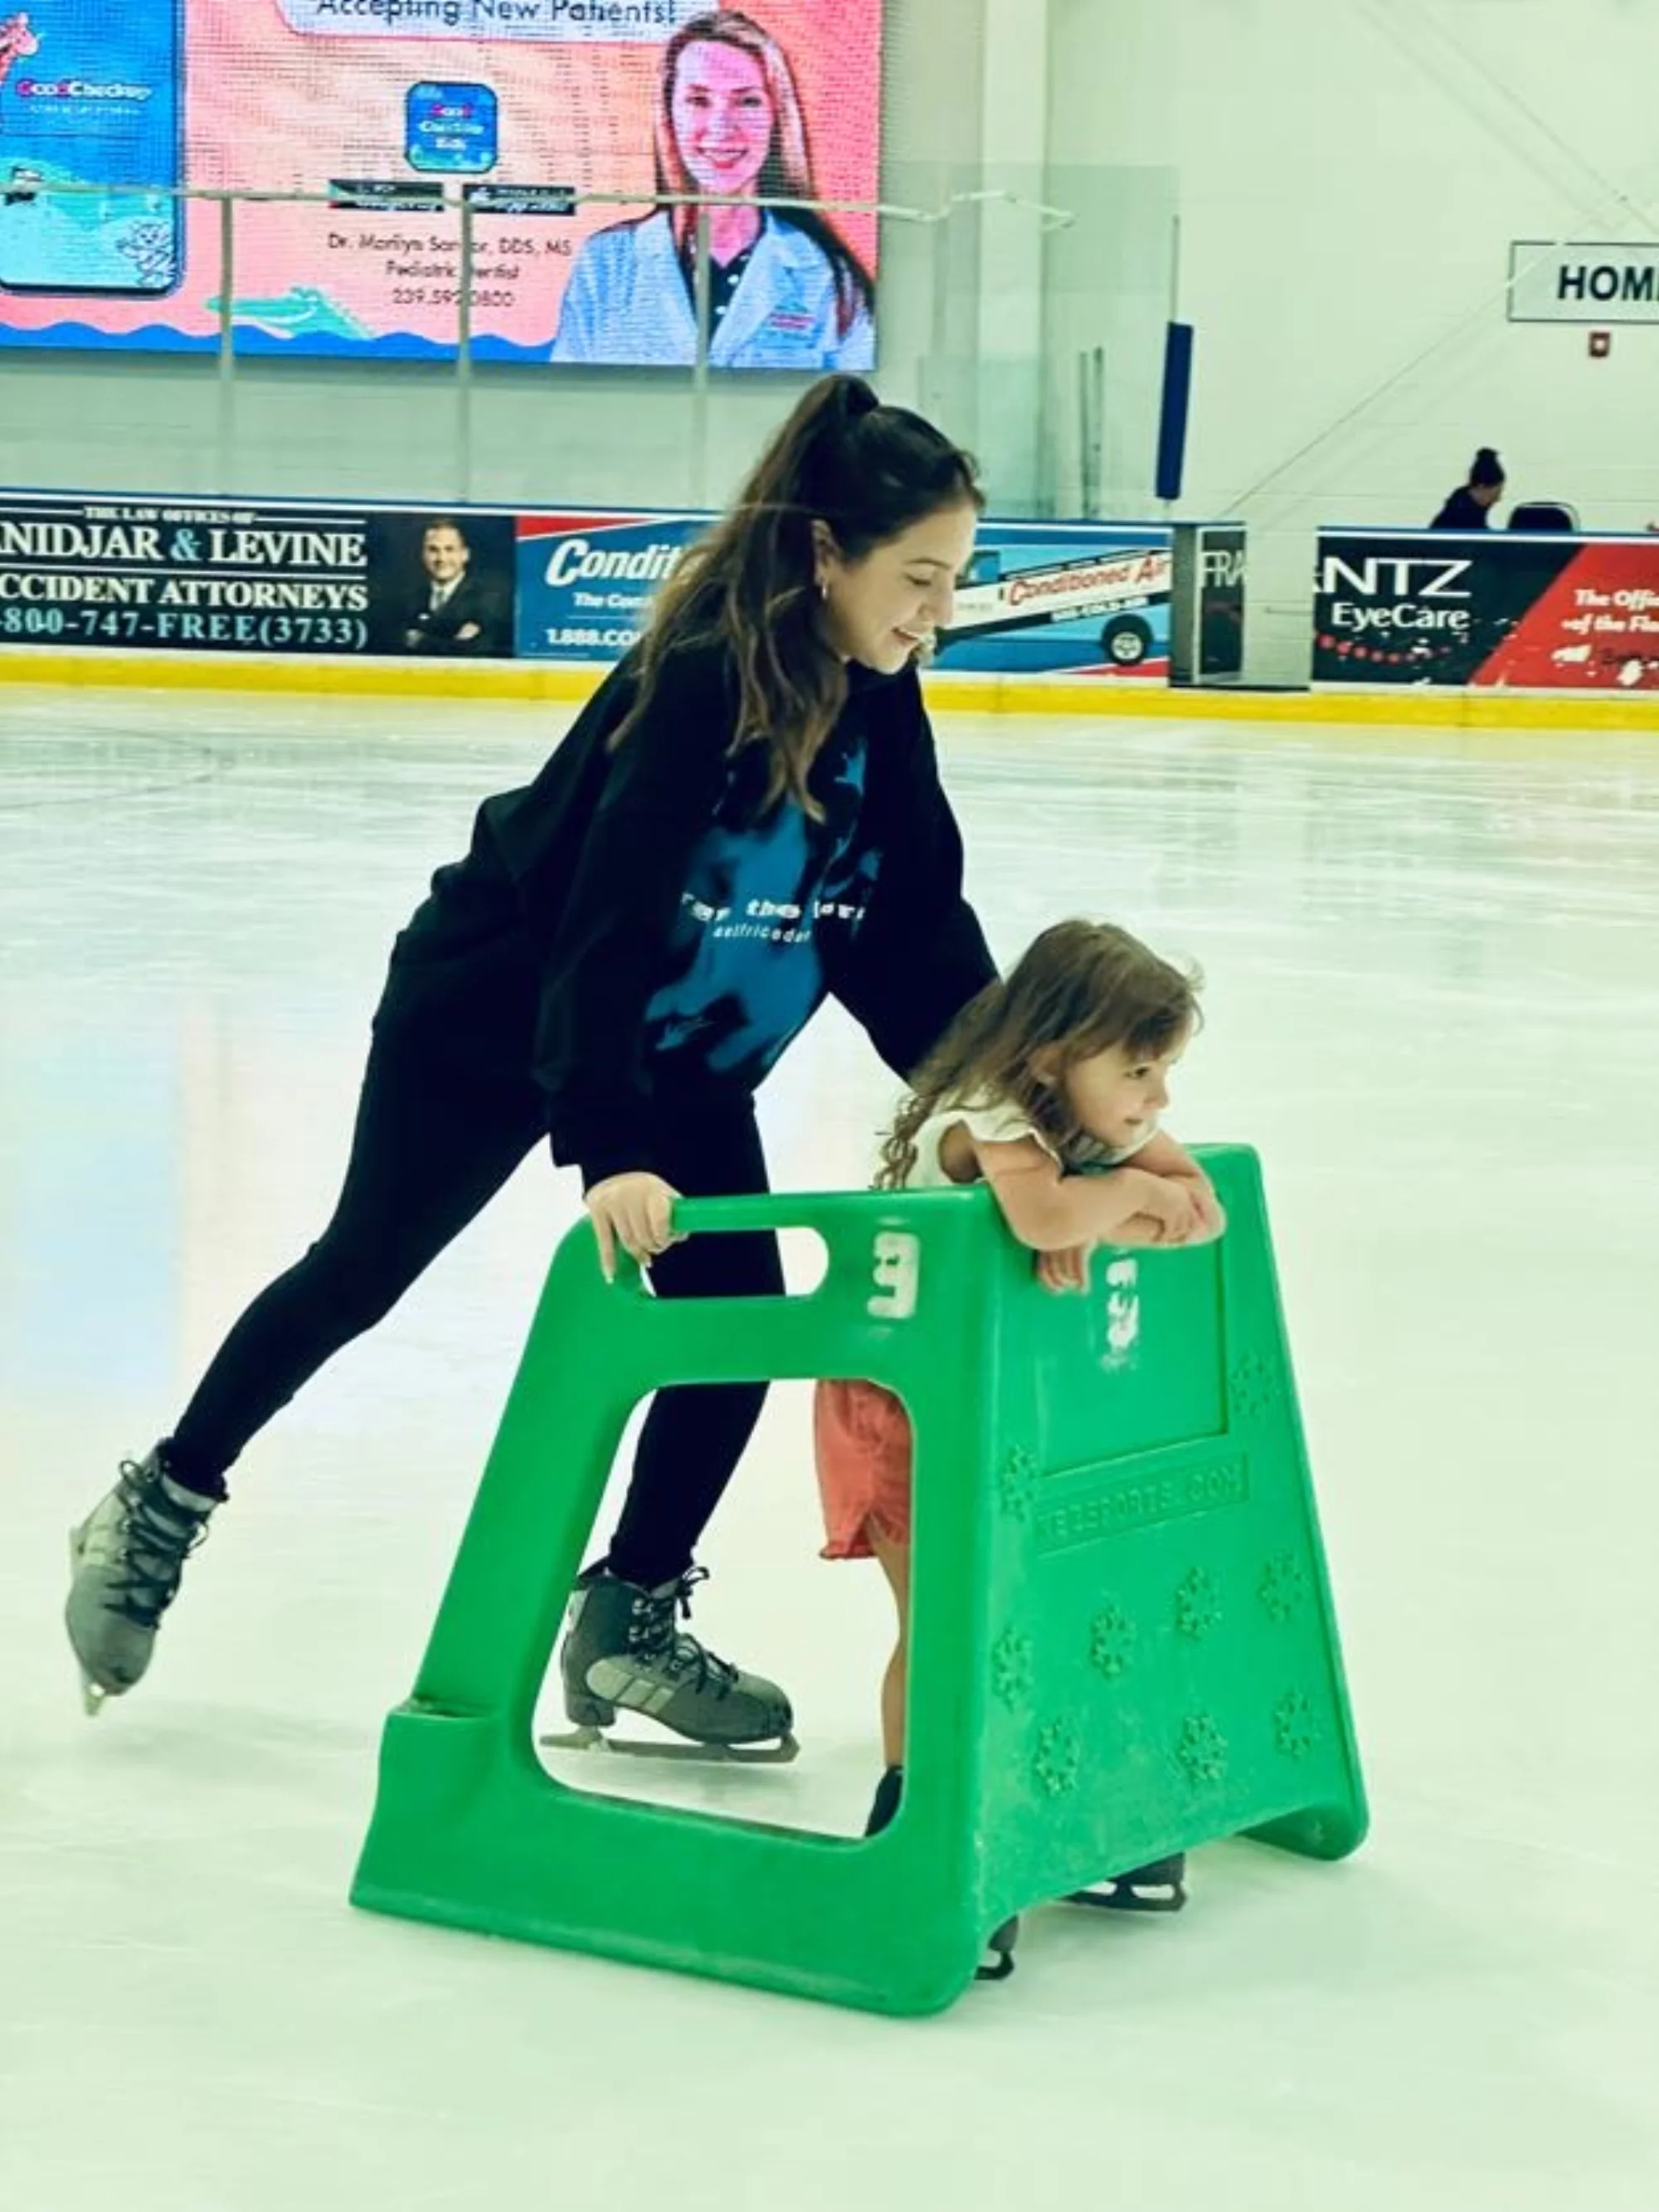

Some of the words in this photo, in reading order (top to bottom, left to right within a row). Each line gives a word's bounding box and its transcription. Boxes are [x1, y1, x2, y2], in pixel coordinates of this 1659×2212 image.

[317, 0, 460, 26] Accepting
[474, 0, 536, 20] New
[552, 0, 674, 23] Patients!
[328, 233, 353, 249] Dr.
[469, 263, 519, 280] entist
[1557, 265, 1659, 302] HOM
[123, 508, 158, 523] LAW
[170, 527, 202, 562] &
[208, 528, 367, 567] LEVINE
[1010, 565, 1132, 606] Conditioned
[1313, 557, 1473, 597] NTZ
[158, 578, 369, 612] ATTORNEYS
[1575, 589, 1610, 607] The
[1331, 601, 1471, 633] EyeCare
